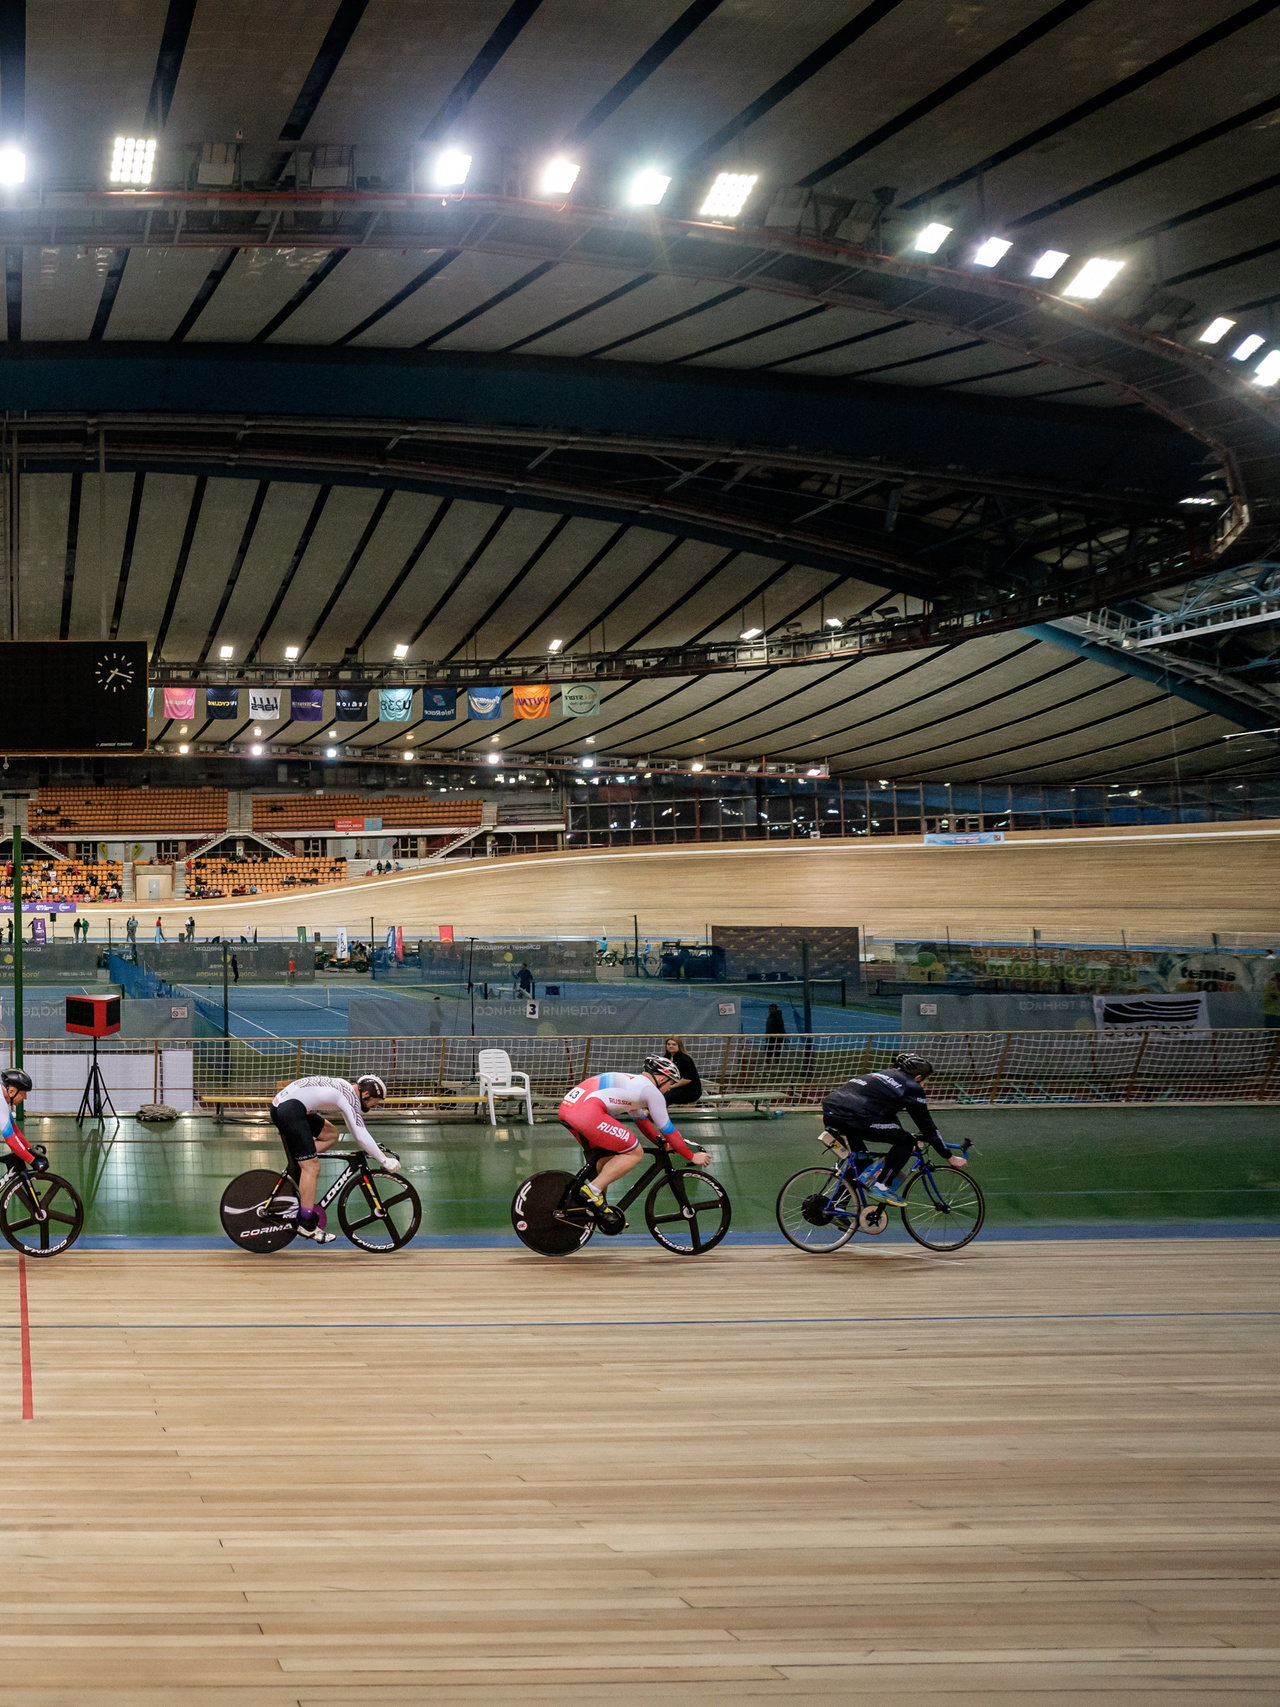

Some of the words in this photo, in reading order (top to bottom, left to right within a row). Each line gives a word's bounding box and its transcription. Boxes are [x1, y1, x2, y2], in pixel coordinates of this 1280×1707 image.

[1180, 966, 1236, 981] tennis
[528, 1004, 537, 1015] 3
[609, 1097, 632, 1106] RUSSIA
[596, 1121, 630, 1142] RUSSIA
[321, 1166, 353, 1208] LOOK
[239, 1222, 293, 1238] CORIMA
[352, 1232, 395, 1250] CORIMA
